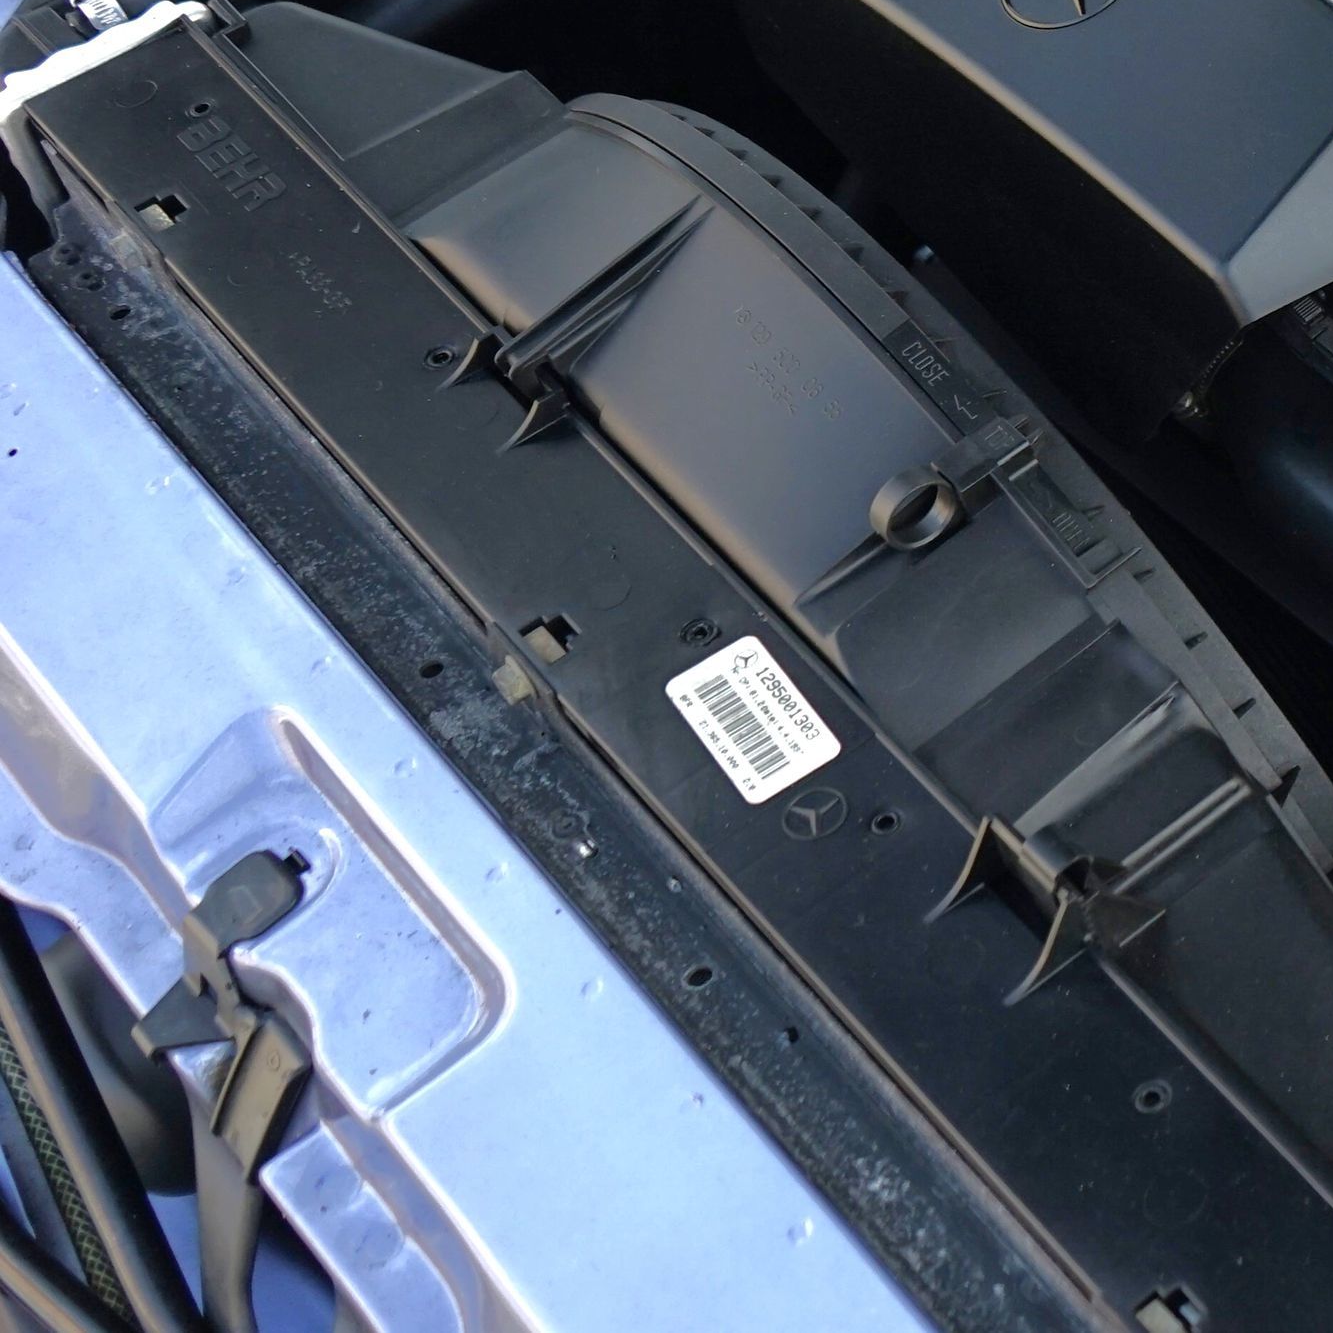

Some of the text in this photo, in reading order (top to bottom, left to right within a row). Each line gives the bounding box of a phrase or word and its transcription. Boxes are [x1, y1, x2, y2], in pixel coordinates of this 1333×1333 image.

[176, 116, 287, 212] BEHR
[901, 341, 950, 387] CLOSE
[756, 667, 820, 741] 1295001303
